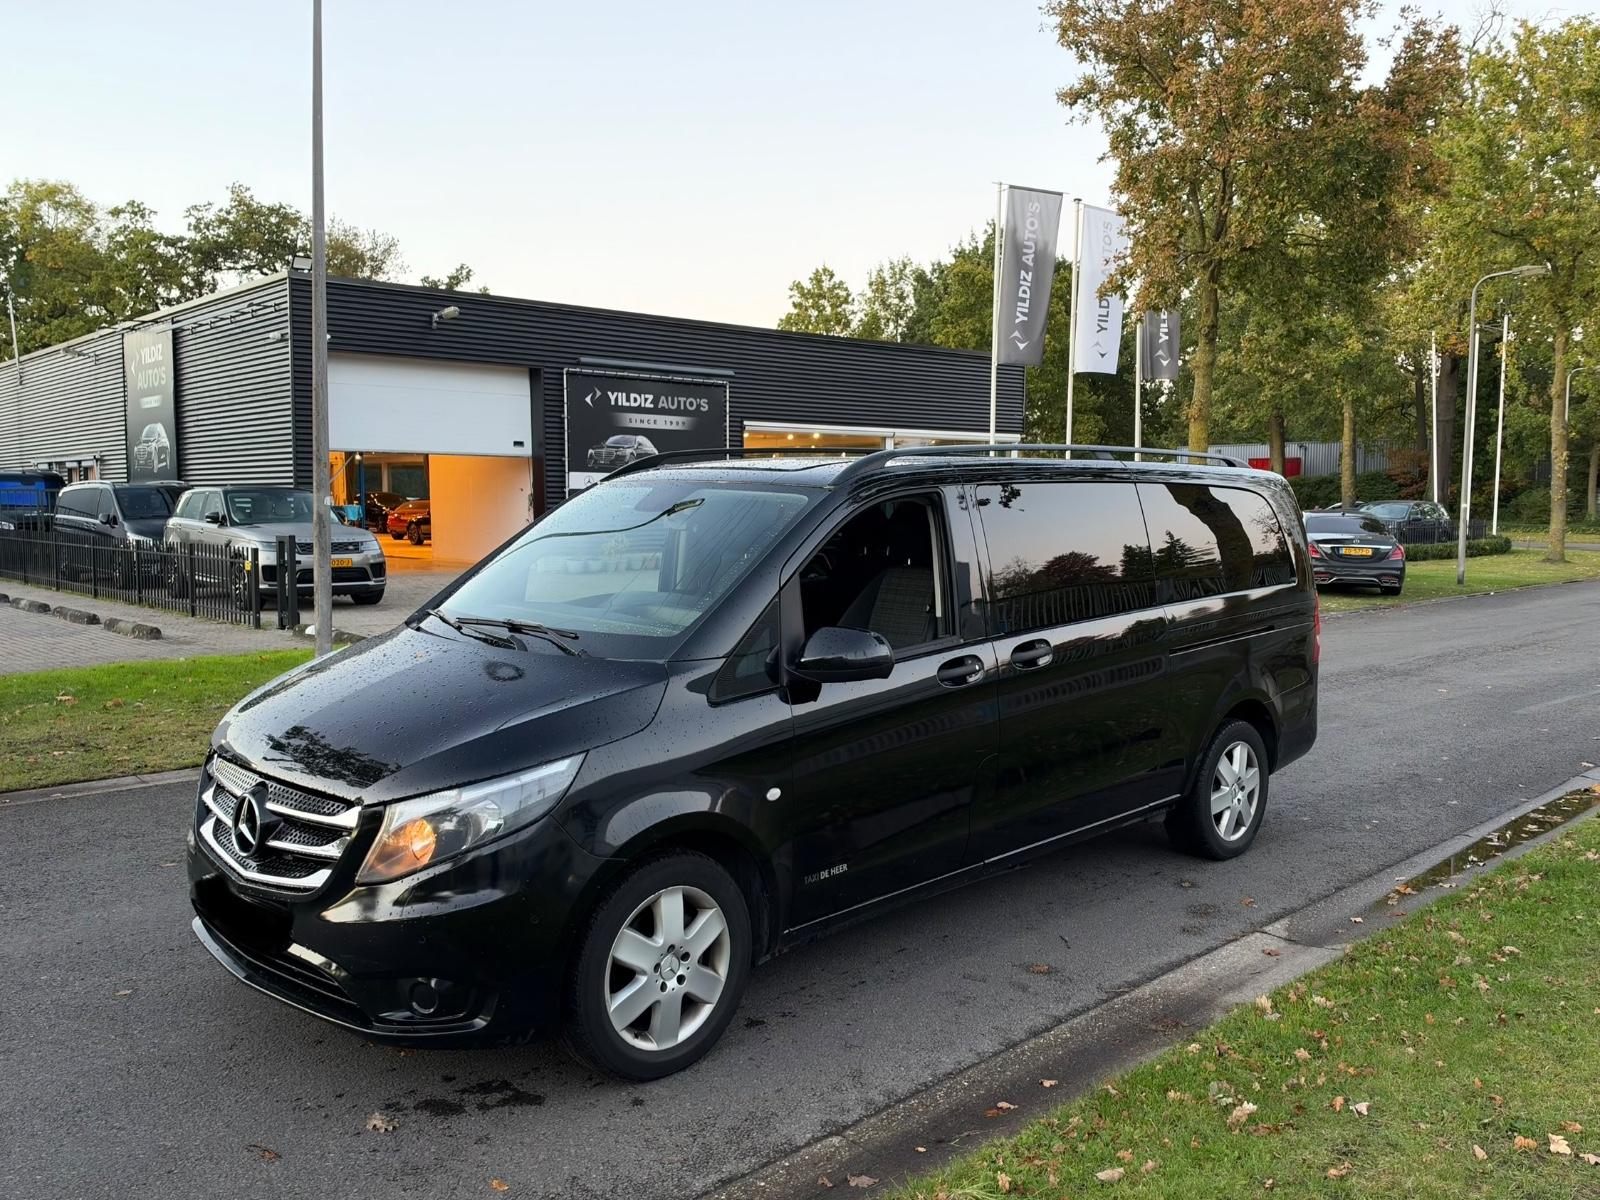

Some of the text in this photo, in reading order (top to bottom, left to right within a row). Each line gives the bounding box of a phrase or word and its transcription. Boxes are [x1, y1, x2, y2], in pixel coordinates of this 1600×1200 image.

[1014, 200, 1040, 325] YILDIZ AUTO'S
[1096, 292, 1112, 334] YILD
[1158, 308, 1169, 344] YILD
[140, 343, 163, 365] YILDIZ
[137, 366, 167, 391] AUTO'S
[607, 391, 709, 412] YILDIZ AUTO'S
[628, 417, 658, 426] SINCE
[804, 863, 848, 885] TAXI DE HEER
